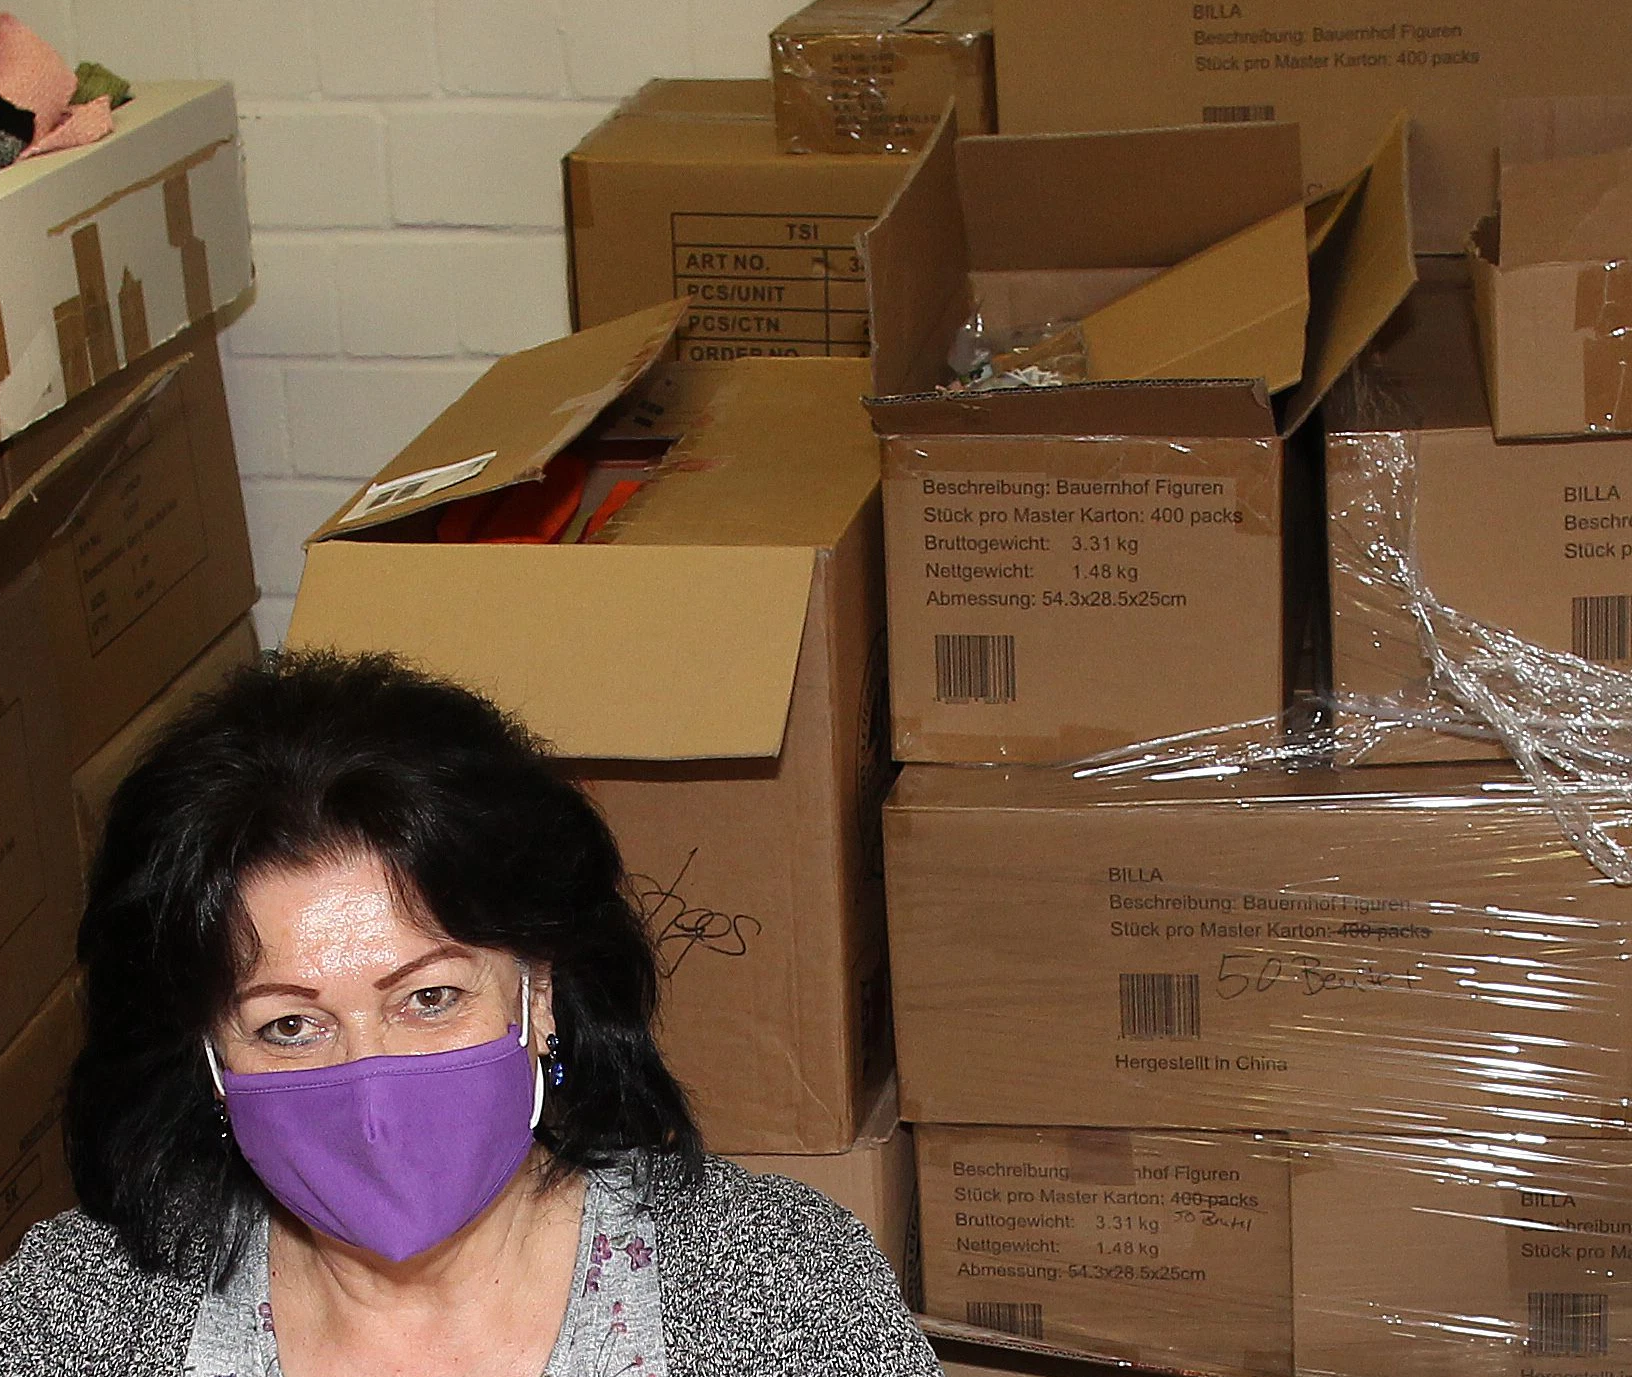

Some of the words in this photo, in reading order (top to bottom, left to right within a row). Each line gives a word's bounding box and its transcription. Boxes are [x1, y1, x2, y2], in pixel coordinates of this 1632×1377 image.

[1192, 4, 1242, 20] BILLA
[1312, 24, 1396, 43] Bauernhof
[1400, 23, 1462, 42] Figuren
[1244, 57, 1269, 72] pro
[1274, 53, 1329, 70] Master
[1396, 50, 1427, 66] 400
[1430, 49, 1480, 67] packs
[786, 222, 819, 242] TSI
[685, 253, 727, 271] ART
[733, 254, 770, 272] NO.
[686, 284, 785, 302] PCS/UNIT
[687, 315, 780, 333] PCS/CTN
[921, 478, 1051, 500] Beschreibung:
[1055, 477, 1152, 498] Bauernhof
[1155, 477, 1225, 501] Figuren
[1563, 484, 1621, 503] BILLA
[922, 504, 975, 525] Stück
[979, 510, 1010, 529] pro
[1013, 506, 1075, 526] Master
[1079, 505, 1145, 525] Karton:
[1150, 506, 1185, 525] 400
[1189, 504, 1244, 529] packs
[924, 534, 1051, 556] Bruttogewicht:
[1071, 535, 1112, 553] 3.31
[1116, 535, 1139, 557] kg
[1563, 538, 1615, 559] Stück
[924, 561, 1035, 583] Nettgewicht:
[1072, 562, 1112, 581] 1.48
[1116, 562, 1139, 585] kg
[925, 588, 1037, 611] Abmessung:
[1041, 590, 1187, 608] 54.3x28.5x25cm
[1108, 866, 1164, 883] BILLA
[1242, 894, 1338, 912] Bauernhof
[1109, 921, 1162, 939] Stück
[1165, 925, 1195, 942] pro
[1200, 922, 1262, 939] Master
[1267, 922, 1331, 940] Karton:
[1216, 953, 1284, 1000] 50
[1114, 1053, 1210, 1074] Hergestellt
[1214, 1054, 1231, 1070] in
[1235, 1054, 1288, 1073] China
[1173, 1165, 1240, 1185] Figuren
[953, 1186, 1003, 1204] Stück
[1006, 1191, 1035, 1208] pro
[1039, 1188, 1098, 1206] Master
[1103, 1190, 1165, 1207] Karton:
[1207, 1191, 1259, 1210] packs
[1520, 1191, 1577, 1209] BILLA
[955, 1212, 1075, 1232] Bruttogewicht:
[1095, 1214, 1132, 1231] 3.31
[1137, 1214, 1159, 1235] kg
[956, 1237, 1060, 1257] Nettgewicht:
[1096, 1240, 1132, 1257] 1.48
[1137, 1240, 1159, 1261] kg
[1520, 1242, 1571, 1261] Stück
[1576, 1246, 1605, 1264] pro
[957, 1262, 1063, 1283] Abmessung:
[1067, 1265, 1206, 1283] 54.3x28.5x25cm
